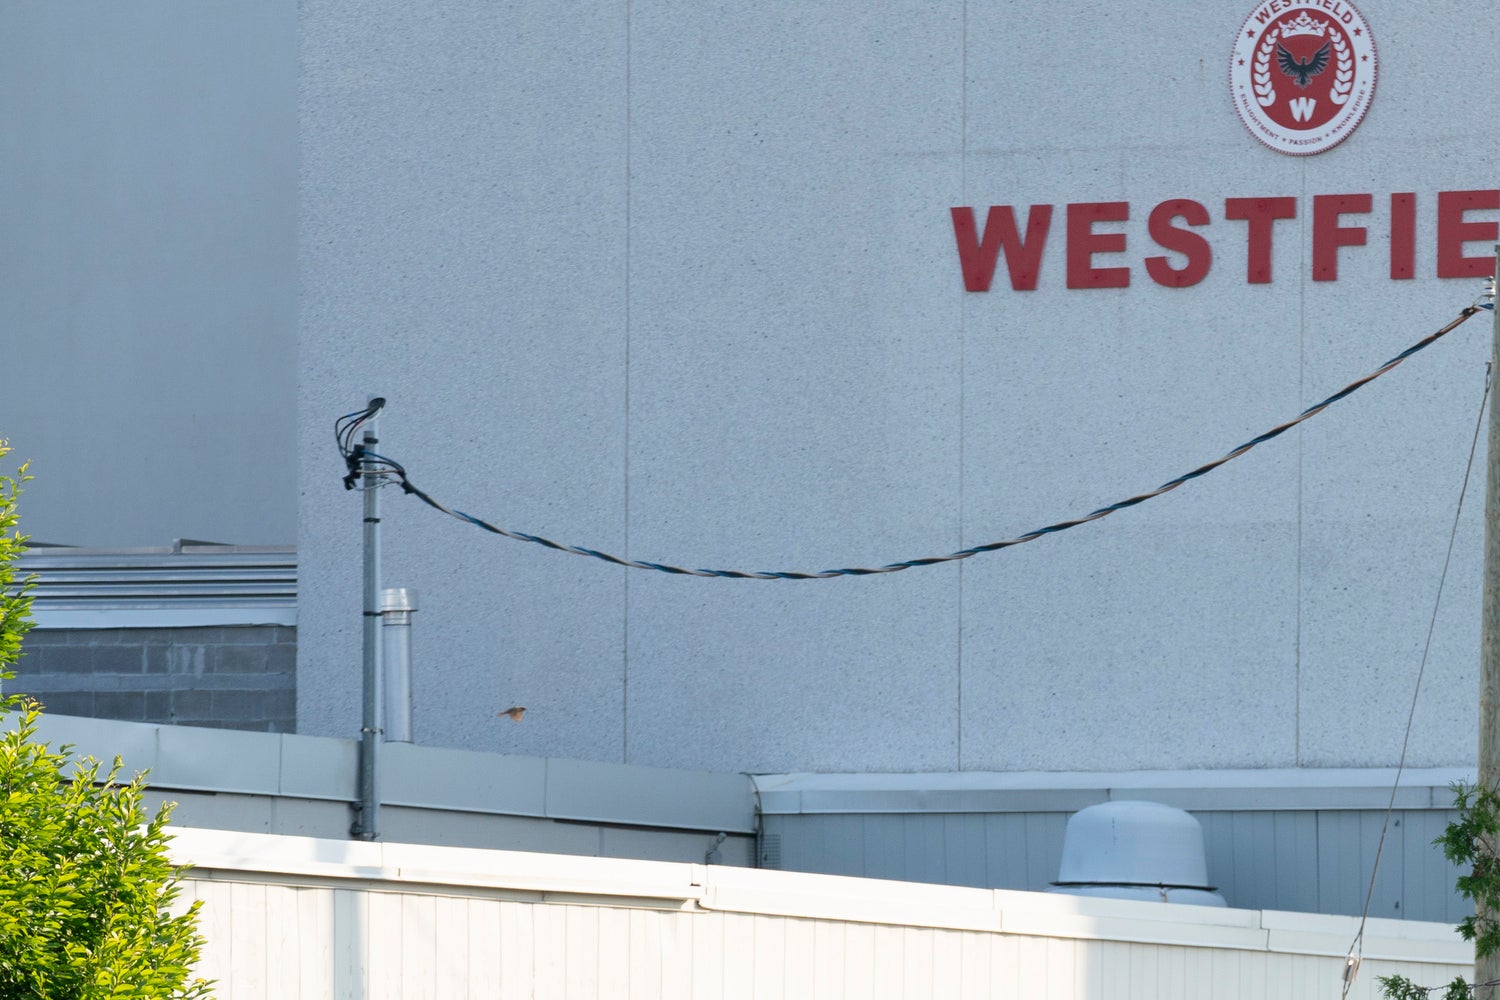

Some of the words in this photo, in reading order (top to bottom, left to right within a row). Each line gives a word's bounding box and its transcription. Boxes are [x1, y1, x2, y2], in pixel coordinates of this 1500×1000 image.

[1255, 0, 1353, 24] WESELD
[1288, 136, 1323, 146] PASSION
[1331, 89, 1366, 135] KNOWLEDGE
[1289, 97, 1316, 122] W
